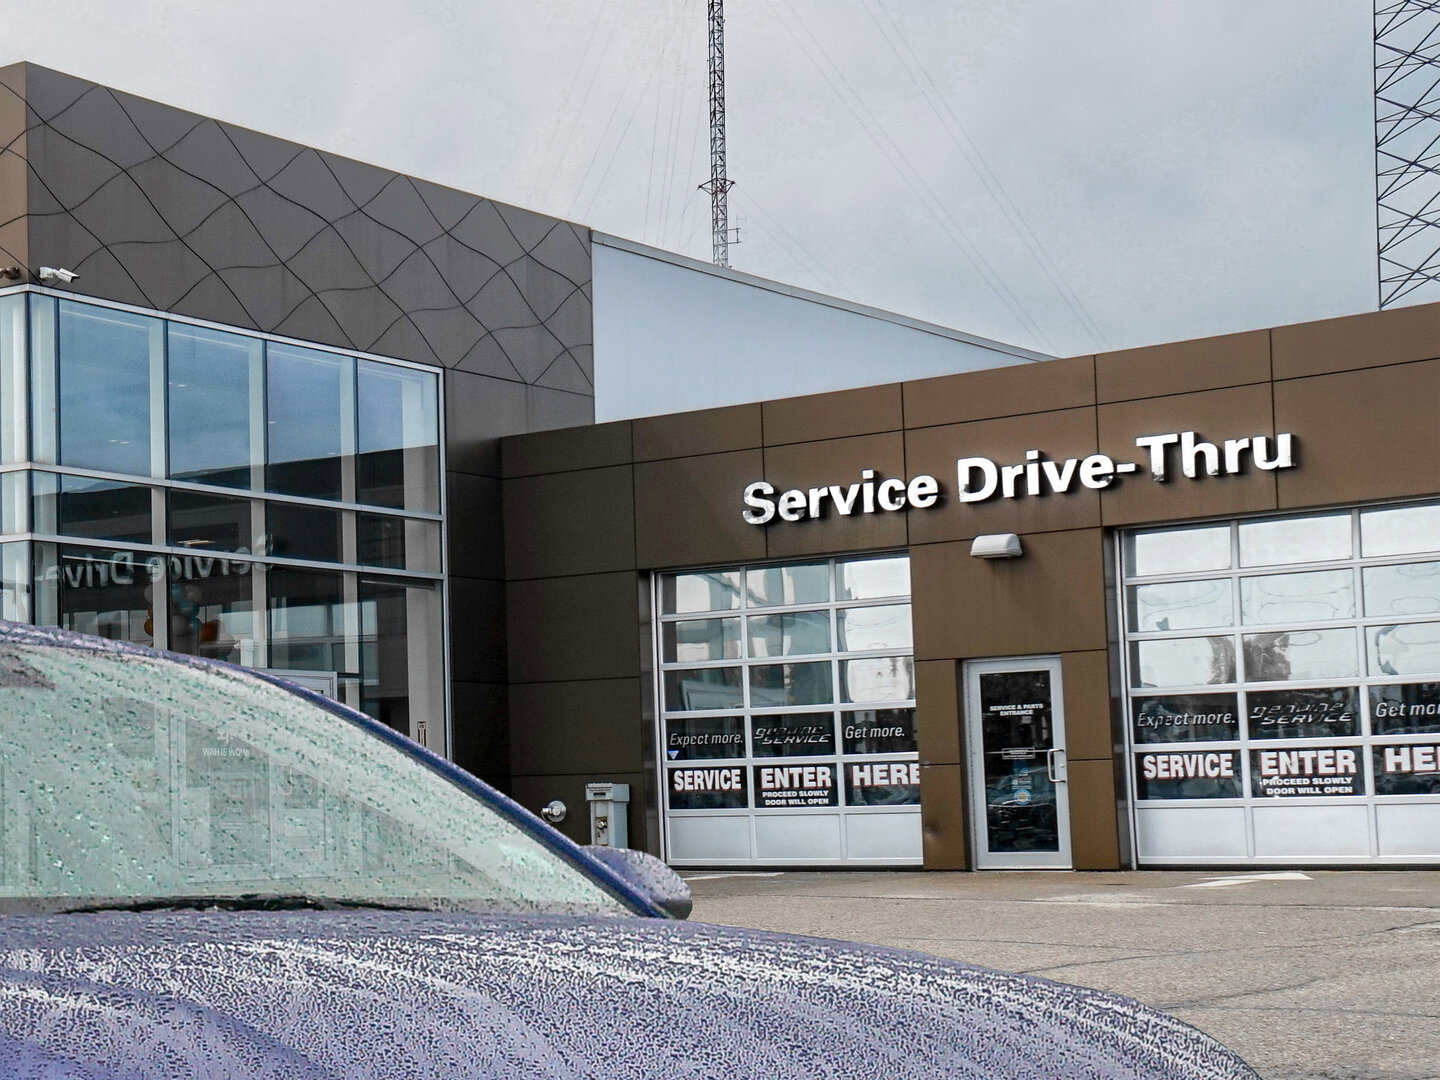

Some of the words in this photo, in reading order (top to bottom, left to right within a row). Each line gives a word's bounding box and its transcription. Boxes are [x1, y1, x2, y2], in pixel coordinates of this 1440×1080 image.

[742, 469, 939, 525] Service
[958, 431, 1297, 503] Drive-Thru
[1375, 702, 1405, 718] Get
[1137, 712, 1191, 728] Expect
[1193, 712, 1236, 725] more.
[1260, 711, 1353, 726] SERVICE
[670, 732, 710, 747] Expect
[711, 732, 744, 744] more.
[762, 733, 831, 745] SERVICE
[845, 725, 868, 739] Get
[870, 726, 906, 738] more.
[1143, 753, 1235, 779] SERVICE
[1260, 749, 1357, 776] ENTER
[673, 769, 742, 791] SERVICE
[760, 766, 832, 789] ENTER
[852, 763, 920, 786] HERE
[1263, 778, 1310, 786] PROCEED
[1312, 776, 1353, 784] SLOWLY
[1266, 787, 1296, 795] DOOR
